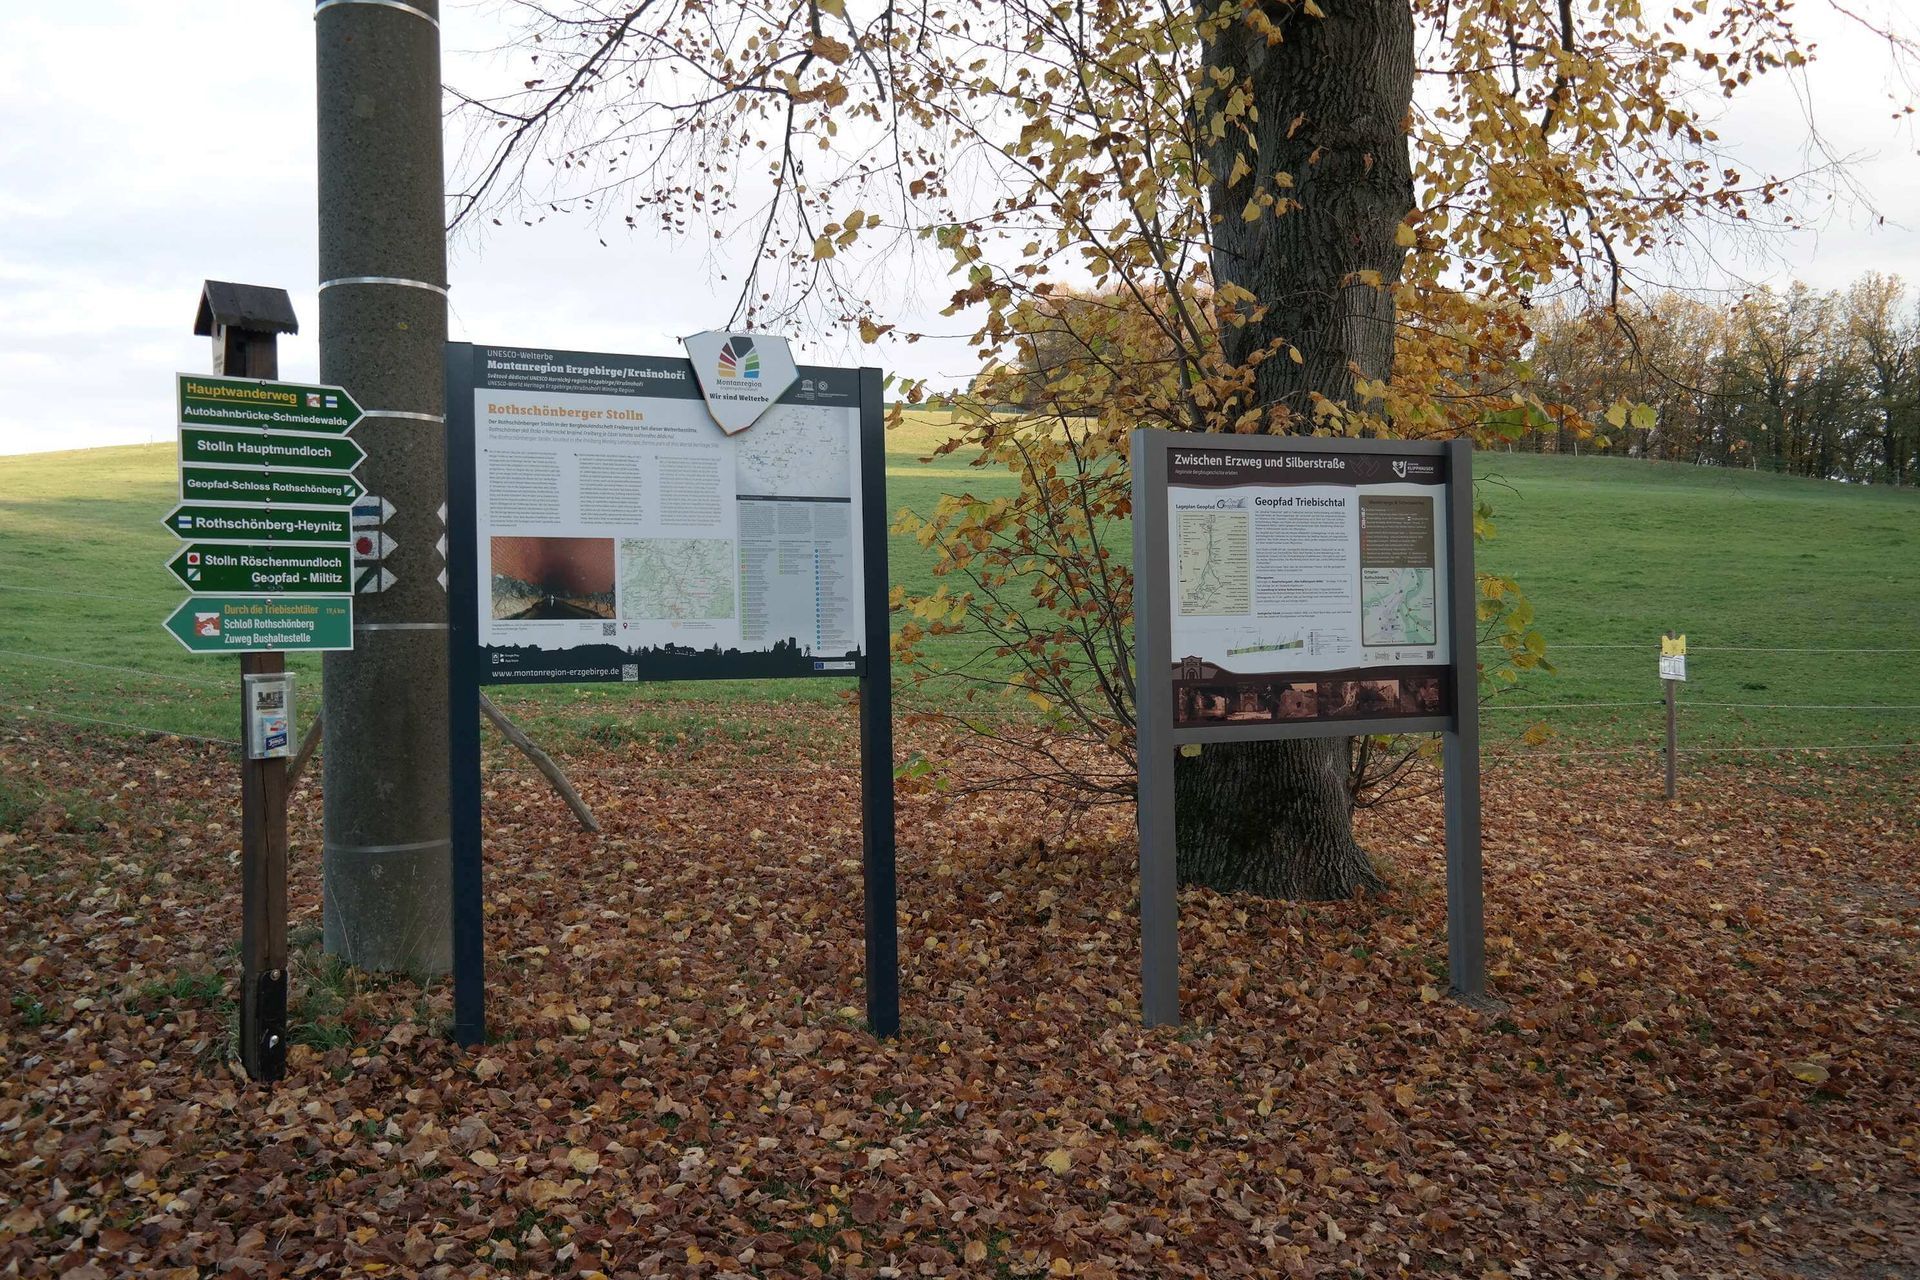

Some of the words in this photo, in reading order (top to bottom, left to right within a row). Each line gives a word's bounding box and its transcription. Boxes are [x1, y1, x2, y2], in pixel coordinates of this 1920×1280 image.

[488, 350, 553, 360] UNESCO-Welterbe
[487, 361, 564, 373] Montanregion
[566, 365, 685, 380] Erzgebirge/Krušnohoří
[717, 379, 761, 388] Montanregion
[187, 382, 297, 403] Hauptwanderweg
[185, 406, 348, 426] Autobahnbrücke-Schmiedewalde
[488, 404, 603, 420] Rothschönberger
[607, 410, 643, 420] Stolln
[198, 440, 234, 452] Stolln
[237, 442, 331, 458] Hauptmundloch
[1175, 454, 1222, 465] Zwischen
[1226, 456, 1262, 468] Erzweg
[1265, 457, 1282, 467] und
[1286, 457, 1345, 468] Silberstraße
[187, 479, 270, 492] Geopfad-Schloss
[273, 483, 342, 496] Rothschönberg
[1255, 497, 1293, 508] Geopfad
[1296, 498, 1345, 506] Triebischtal
[196, 517, 342, 533] Rothschönberg-Heynitz
[205, 555, 237, 566] Stolln
[240, 556, 342, 568] Röschenmundloch
[252, 572, 299, 584] Geopfad
[310, 573, 342, 583] Miltitz
[224, 604, 248, 614] Durch
[250, 605, 262, 614] die
[265, 605, 319, 615] Triebischtäler
[224, 619, 252, 629] Schloß
[255, 619, 314, 630] Rothschönberg
[224, 634, 252, 645] Zuweg
[253, 633, 311, 643] Bushaltestelle
[492, 668, 619, 678] www.montanregion-erzgebirge.de
